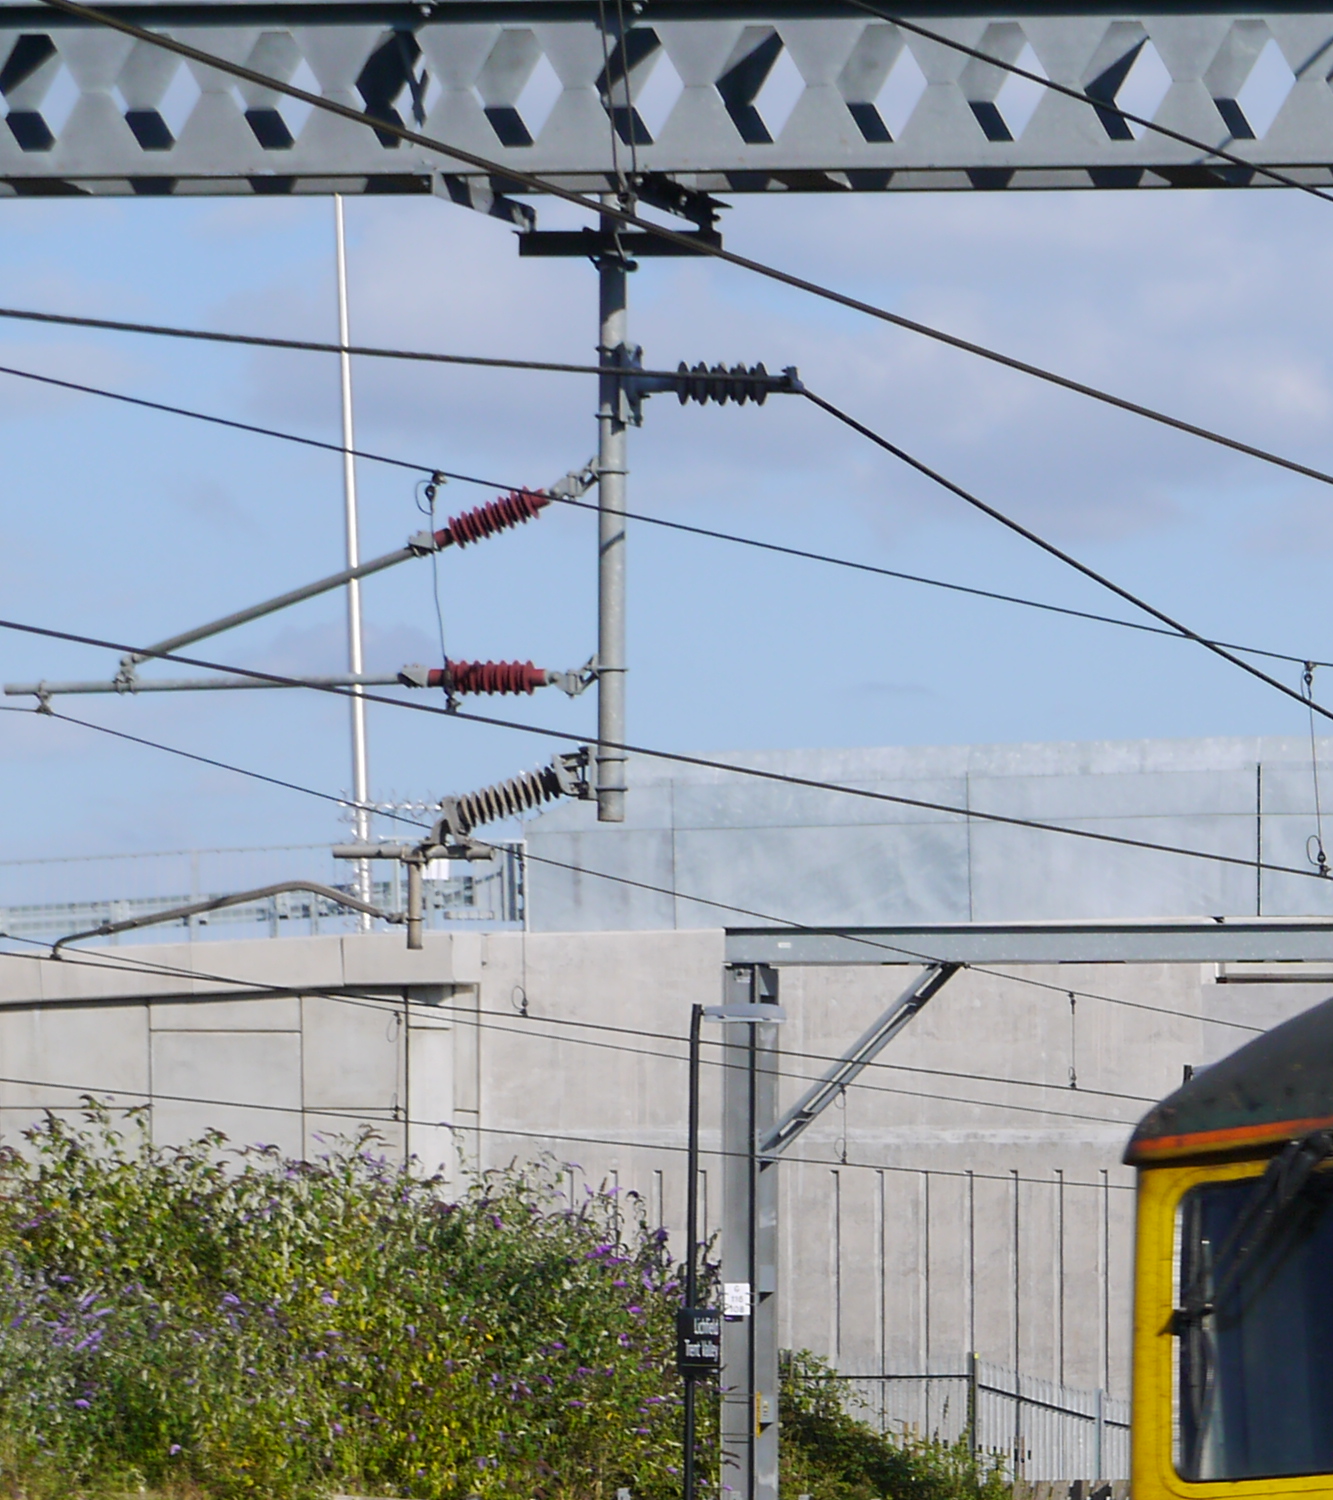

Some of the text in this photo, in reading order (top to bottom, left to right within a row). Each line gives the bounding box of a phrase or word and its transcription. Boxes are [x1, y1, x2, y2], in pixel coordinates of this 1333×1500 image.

[693, 1317, 719, 1335] Lichfield
[683, 1339, 719, 1362] Trent Valley
